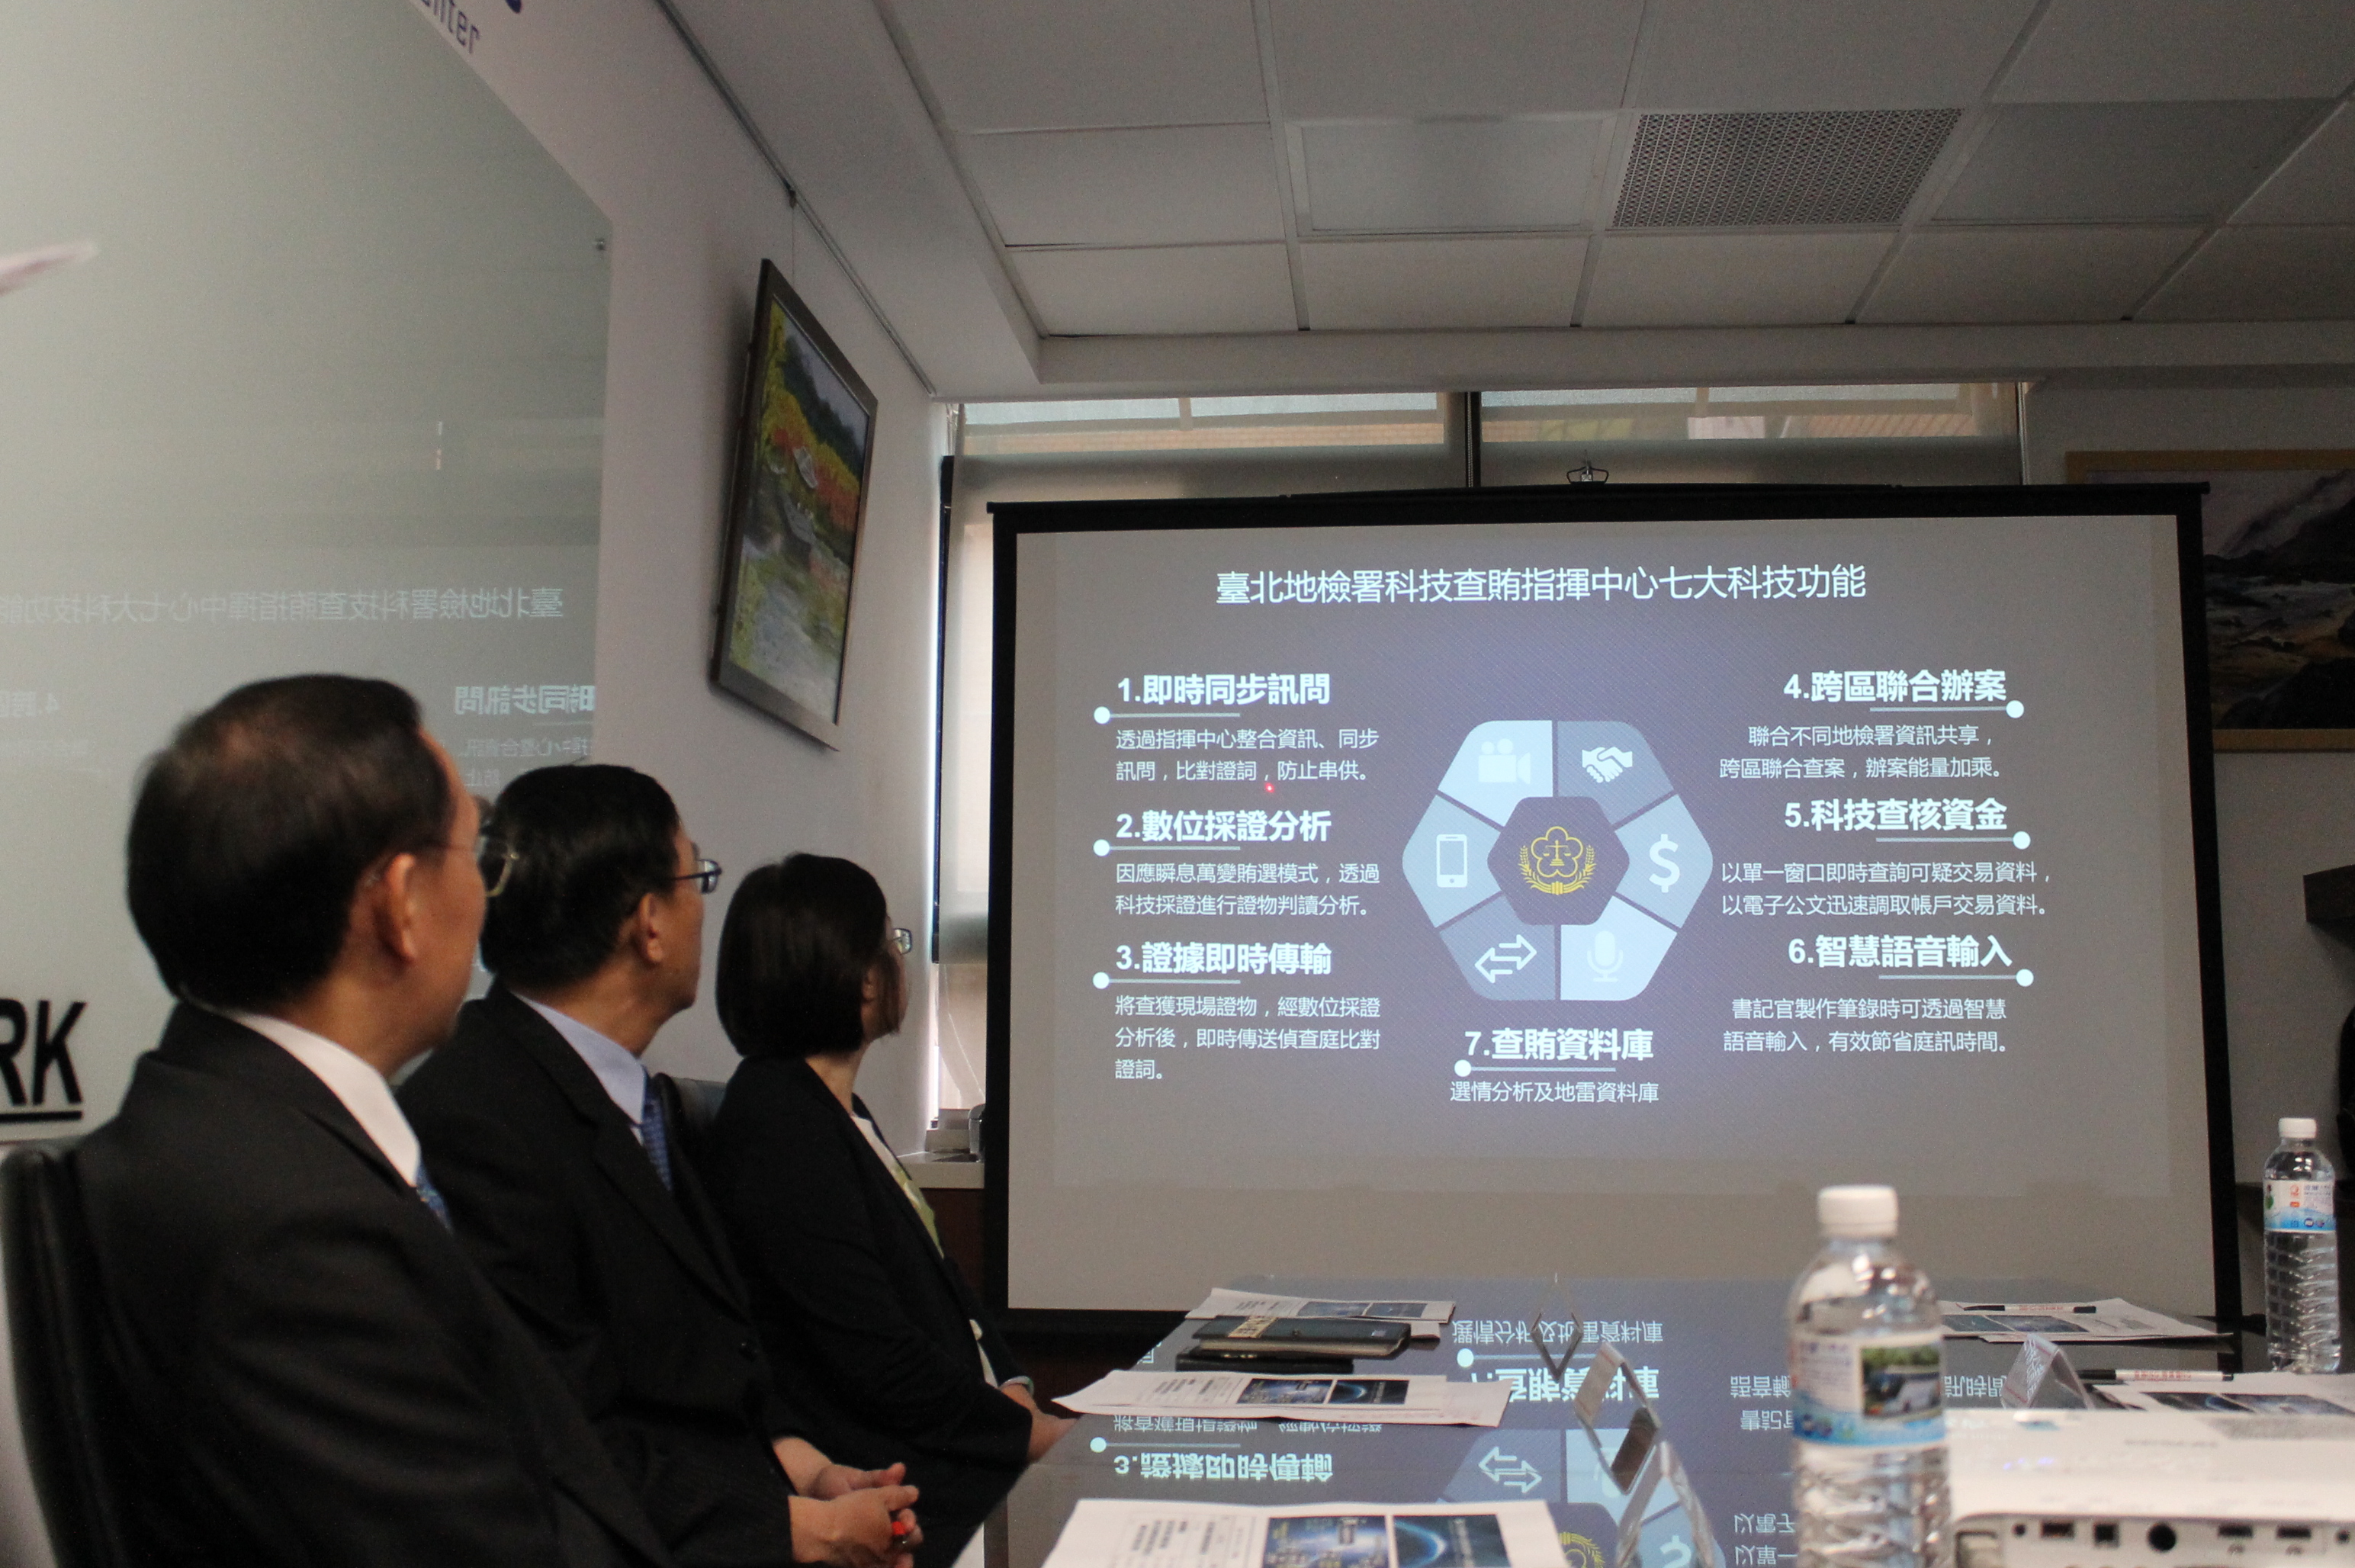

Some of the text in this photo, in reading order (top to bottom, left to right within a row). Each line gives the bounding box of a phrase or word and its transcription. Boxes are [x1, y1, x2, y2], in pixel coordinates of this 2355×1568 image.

[422, 0, 480, 54] nter
[1216, 563, 1867, 606] 臺北地檢署科技查賄指揮中心七大科技功能
[1117, 673, 1331, 705] 1.即時同步訊問
[1783, 668, 2007, 702] 4.跨區聯合辦案
[1116, 809, 1332, 843] 2.數位採證分析
[1785, 797, 2008, 831] 5.科技查核資金
[1116, 941, 1332, 975] 3.證據即時傳輸
[1788, 934, 2013, 968] 6.智慧語音輸入
[1731, 997, 2007, 1020] 書記官製作筆錄時可透過智慧
[1464, 1027, 1655, 1061] 7.查賄資料庫
[1450, 1081, 1659, 1104] 選情分析及地雷資料庫
